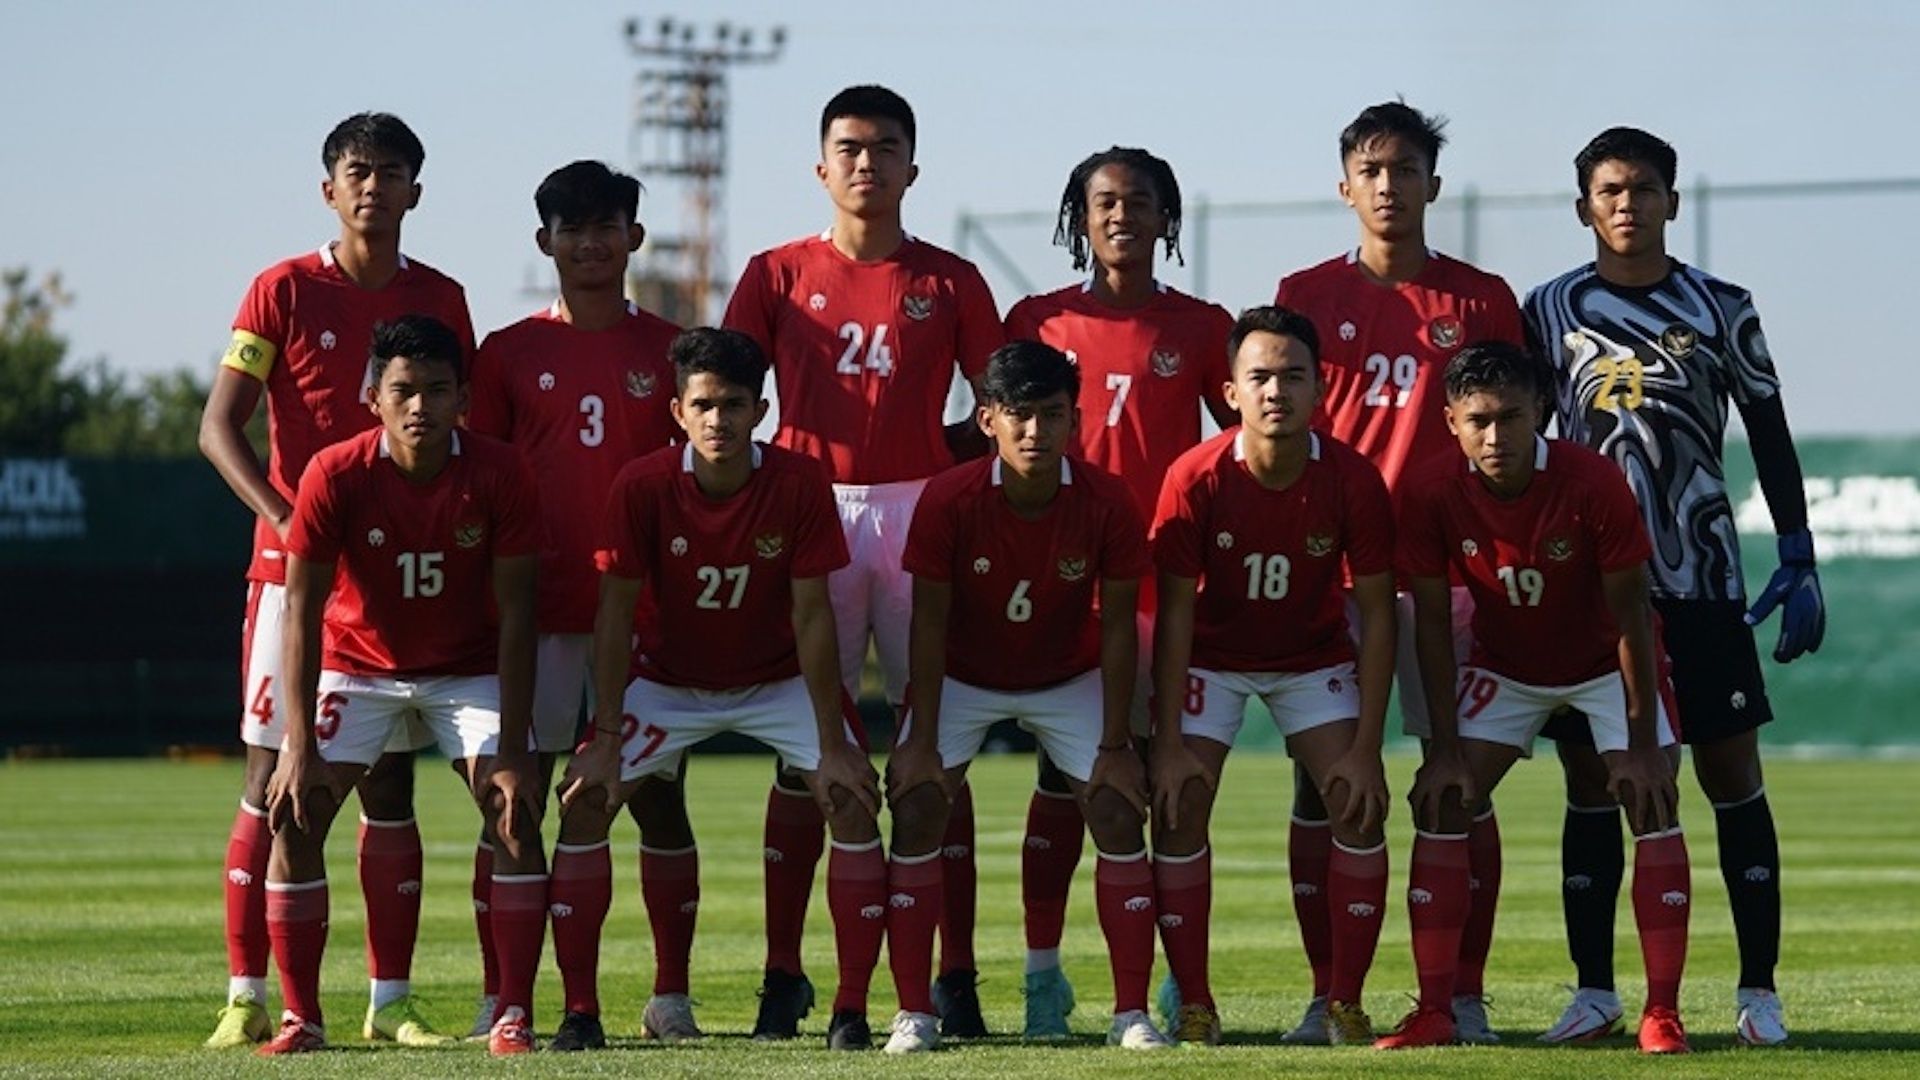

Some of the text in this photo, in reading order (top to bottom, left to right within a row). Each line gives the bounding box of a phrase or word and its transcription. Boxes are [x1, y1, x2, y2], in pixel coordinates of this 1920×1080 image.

[836, 321, 893, 377] 24
[1106, 372, 1132, 427] 7
[1364, 353, 1418, 408] 29
[1593, 357, 1643, 410] 23
[579, 394, 605, 447] 3
[396, 552, 445, 598] 15
[696, 564, 750, 609] 27
[1243, 552, 1291, 600] 18
[1497, 566, 1545, 607] 19
[1007, 579, 1032, 622] 6
[250, 675, 274, 726] 4
[1457, 670, 1499, 719] 19
